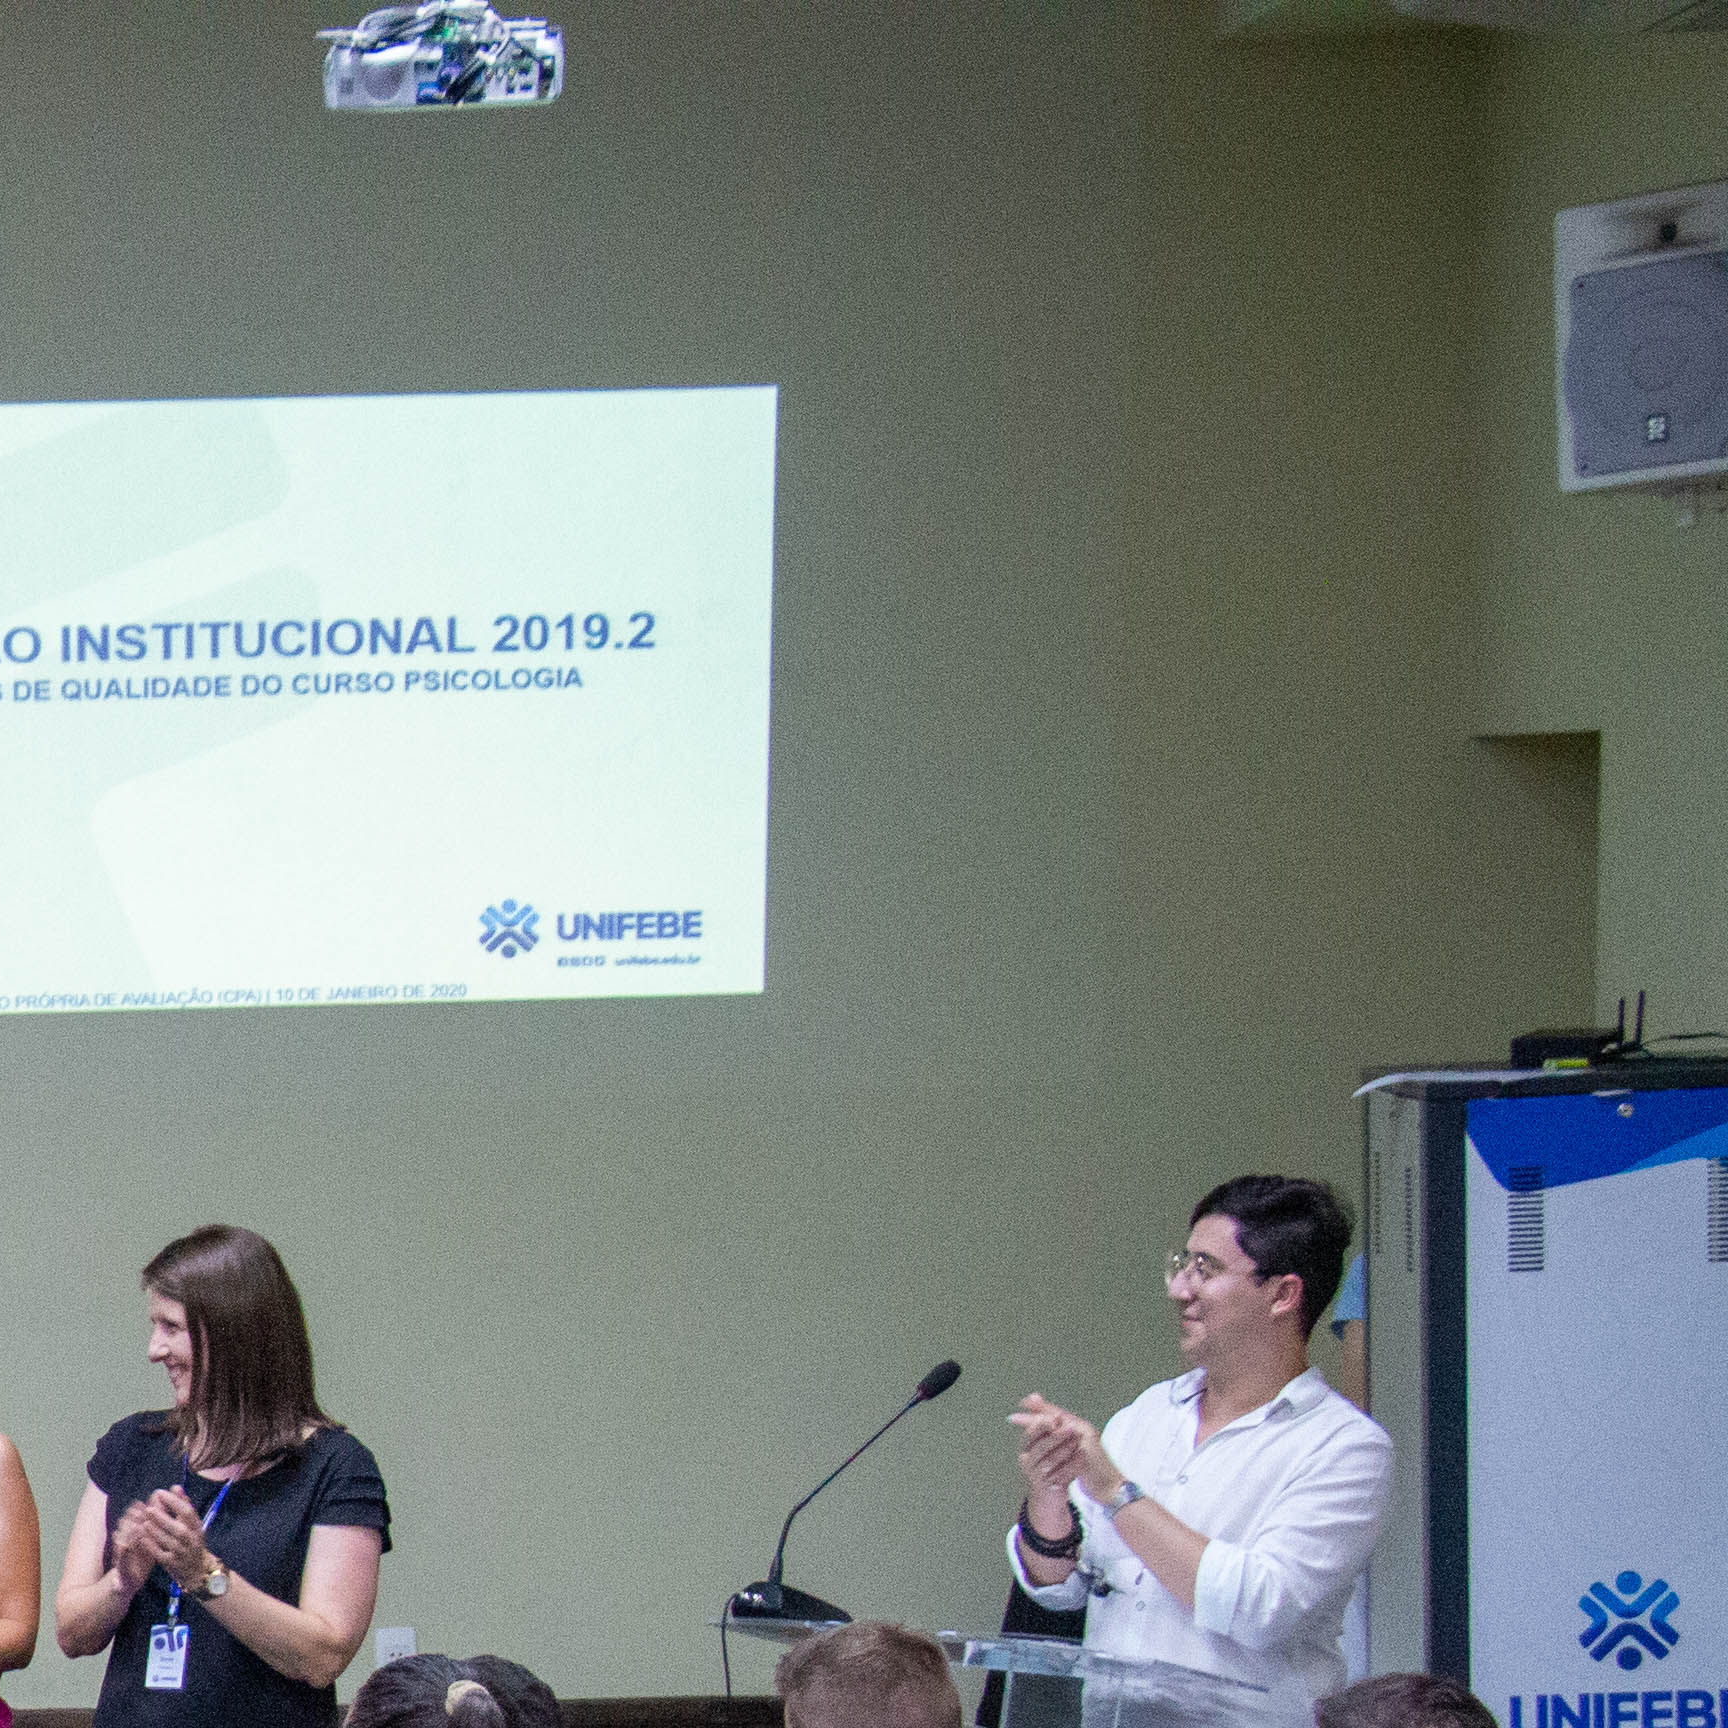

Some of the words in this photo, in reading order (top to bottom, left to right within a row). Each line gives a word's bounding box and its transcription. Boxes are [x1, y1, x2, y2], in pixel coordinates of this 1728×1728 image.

[61, 615, 476, 663] INSTITUCIONAL
[493, 611, 657, 653] 2019.2
[13, 680, 51, 702] DE
[60, 674, 232, 702] QUALIDADE
[241, 674, 282, 697] DO
[291, 671, 395, 695] CURSO
[405, 666, 583, 692] PSICOLOGIA
[557, 911, 702, 940] UNIFEBE
[15, 991, 91, 1009] PRÓPRIA
[96, 992, 117, 1006] DE
[121, 988, 212, 1008] AVALIAÇÃO
[218, 988, 261, 1004] (CPA)
[276, 989, 294, 1002] 10
[299, 987, 320, 1000] DE
[327, 984, 397, 999] JANEIRO
[403, 984, 425, 998] DE
[431, 983, 468, 998] 2020
